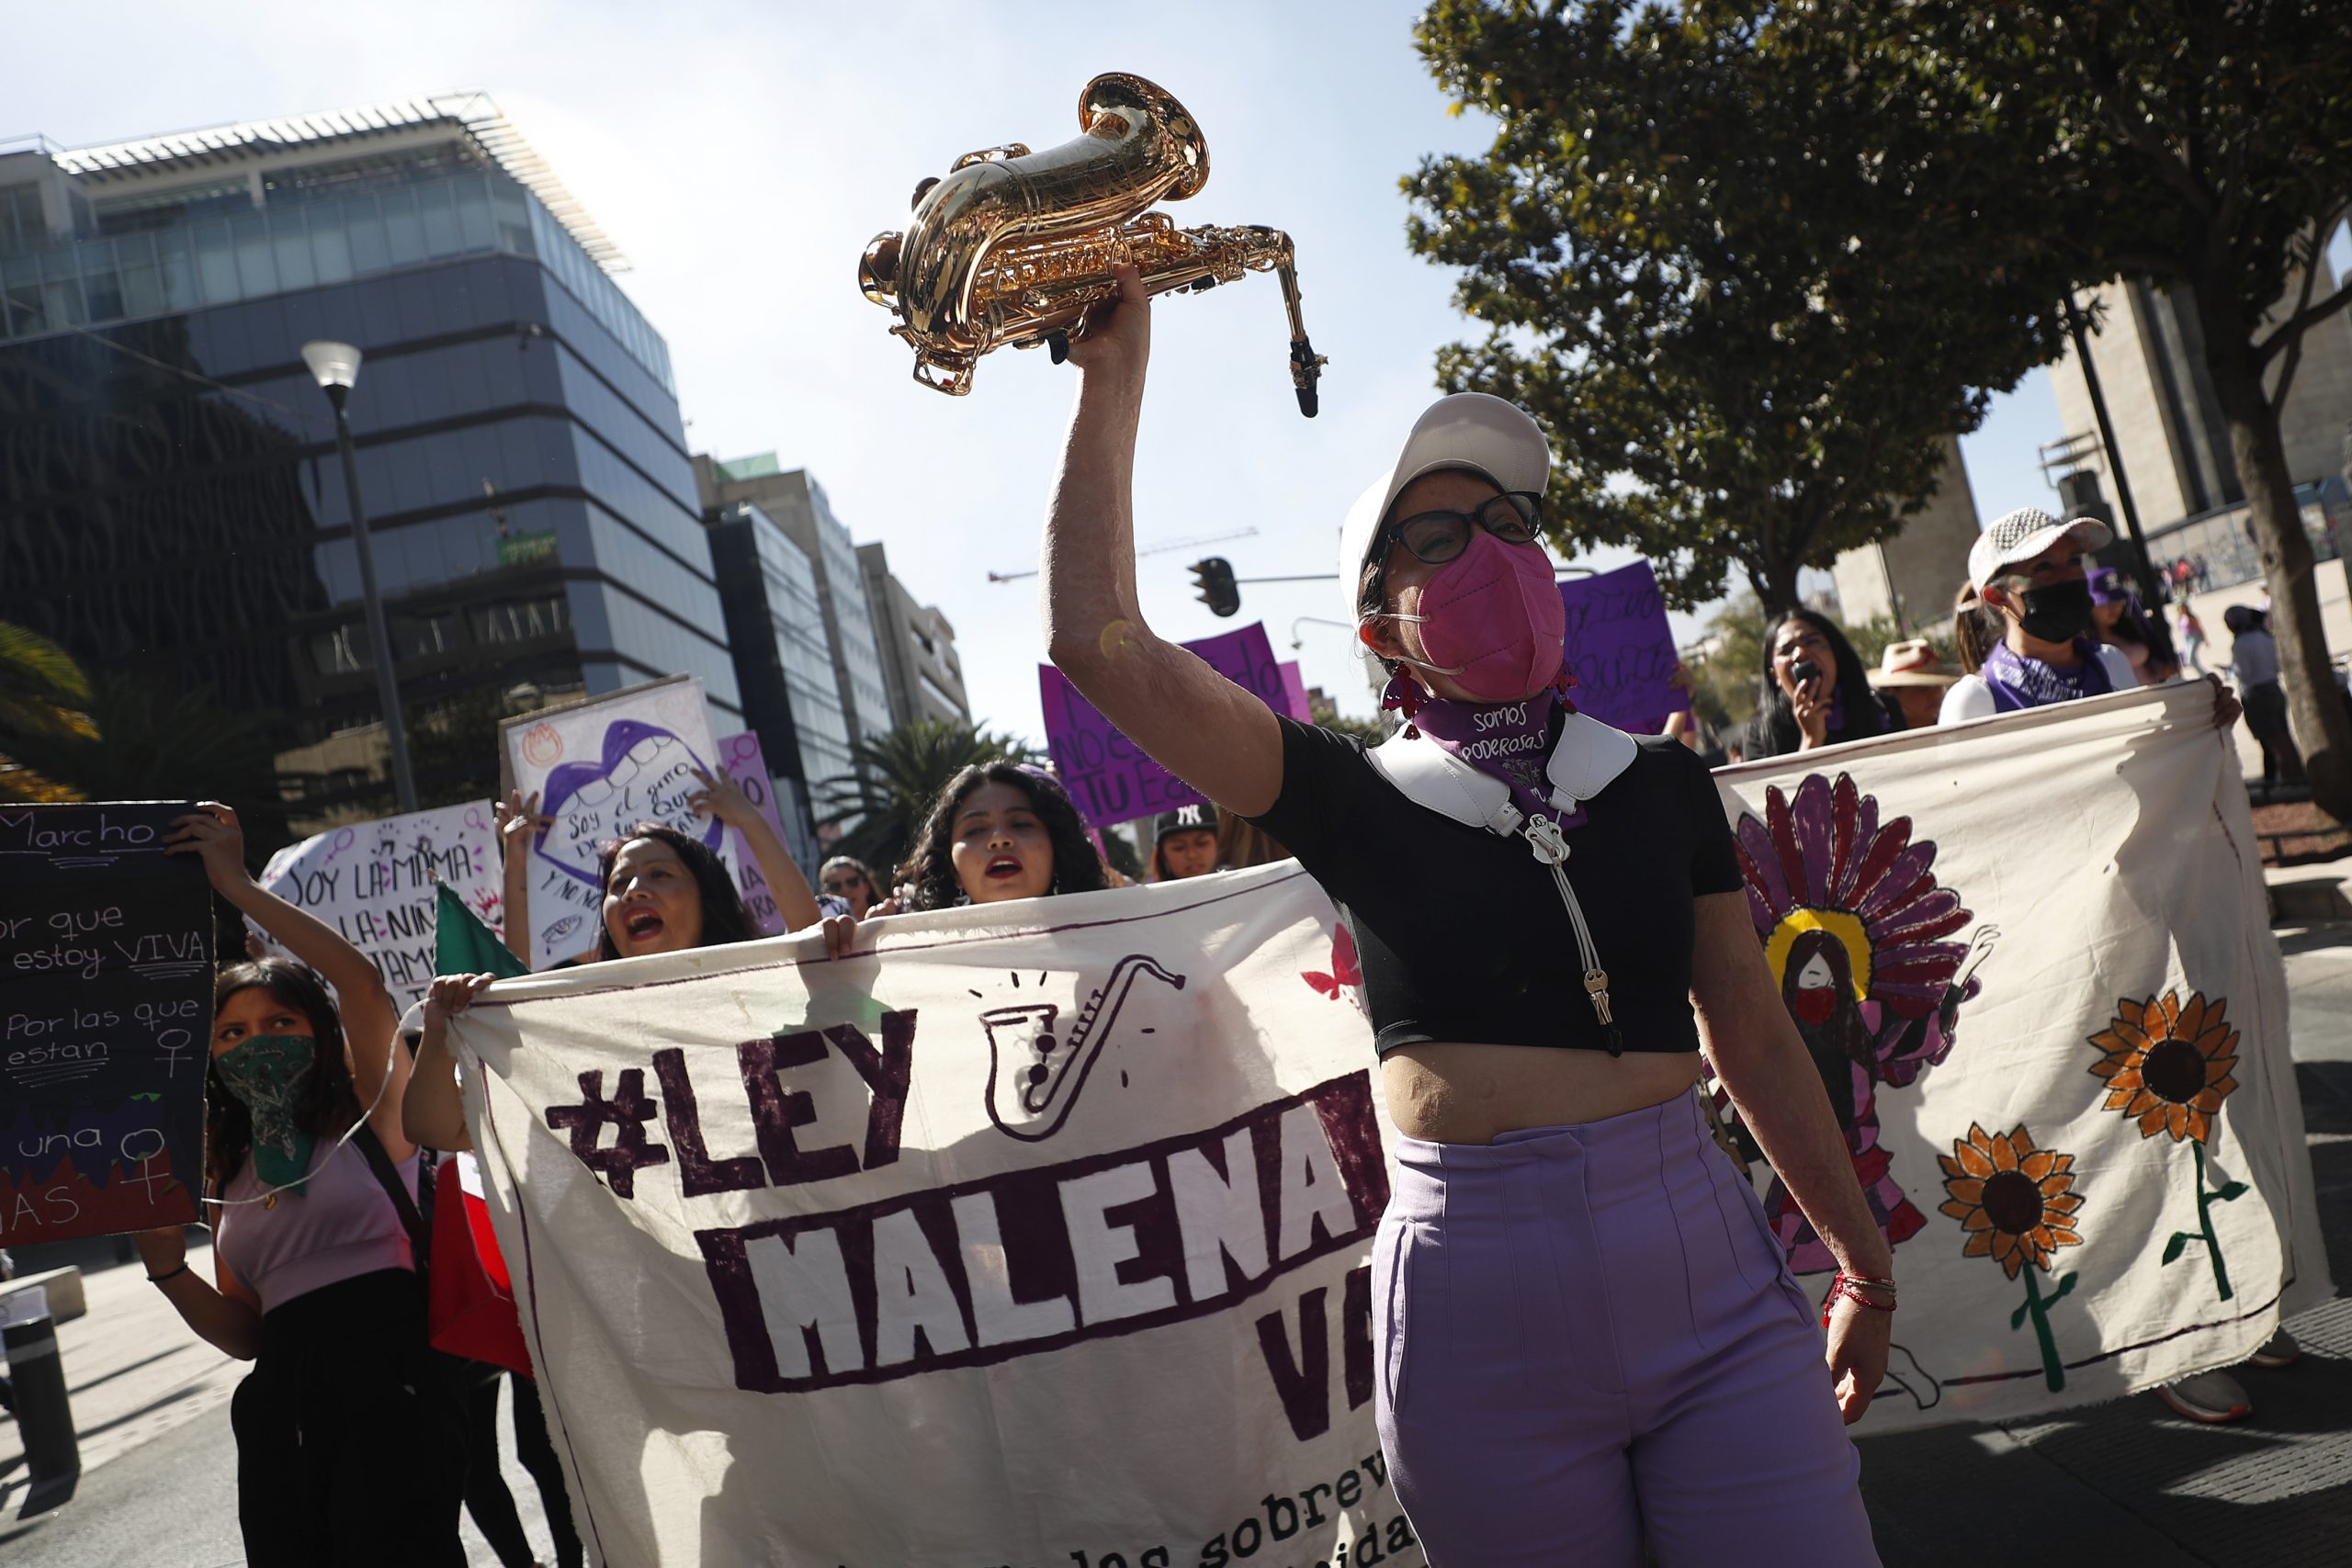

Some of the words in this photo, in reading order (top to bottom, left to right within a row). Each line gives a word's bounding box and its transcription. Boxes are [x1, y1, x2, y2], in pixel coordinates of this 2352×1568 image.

[0, 811, 154, 847] Marcho
[279, 857, 340, 907] SOY
[354, 860, 384, 900] LA
[392, 831, 472, 892] MAMÁ
[48, 906, 124, 942] que
[338, 909, 380, 947] LA
[386, 897, 436, 942] NIÑ
[13, 943, 107, 980] estoy
[113, 931, 207, 963] VIVA
[6, 1013, 64, 1041] Por
[73, 1008, 120, 1031] las
[133, 998, 199, 1032] que
[7, 1041, 108, 1065] estan
[546, 1009, 918, 1200] #LEY
[18, 1128, 103, 1157] una
[0, 1186, 80, 1235] AS
[743, 1100, 1355, 1381] MALENA
[1200, 1449, 1386, 1568] sobrev
